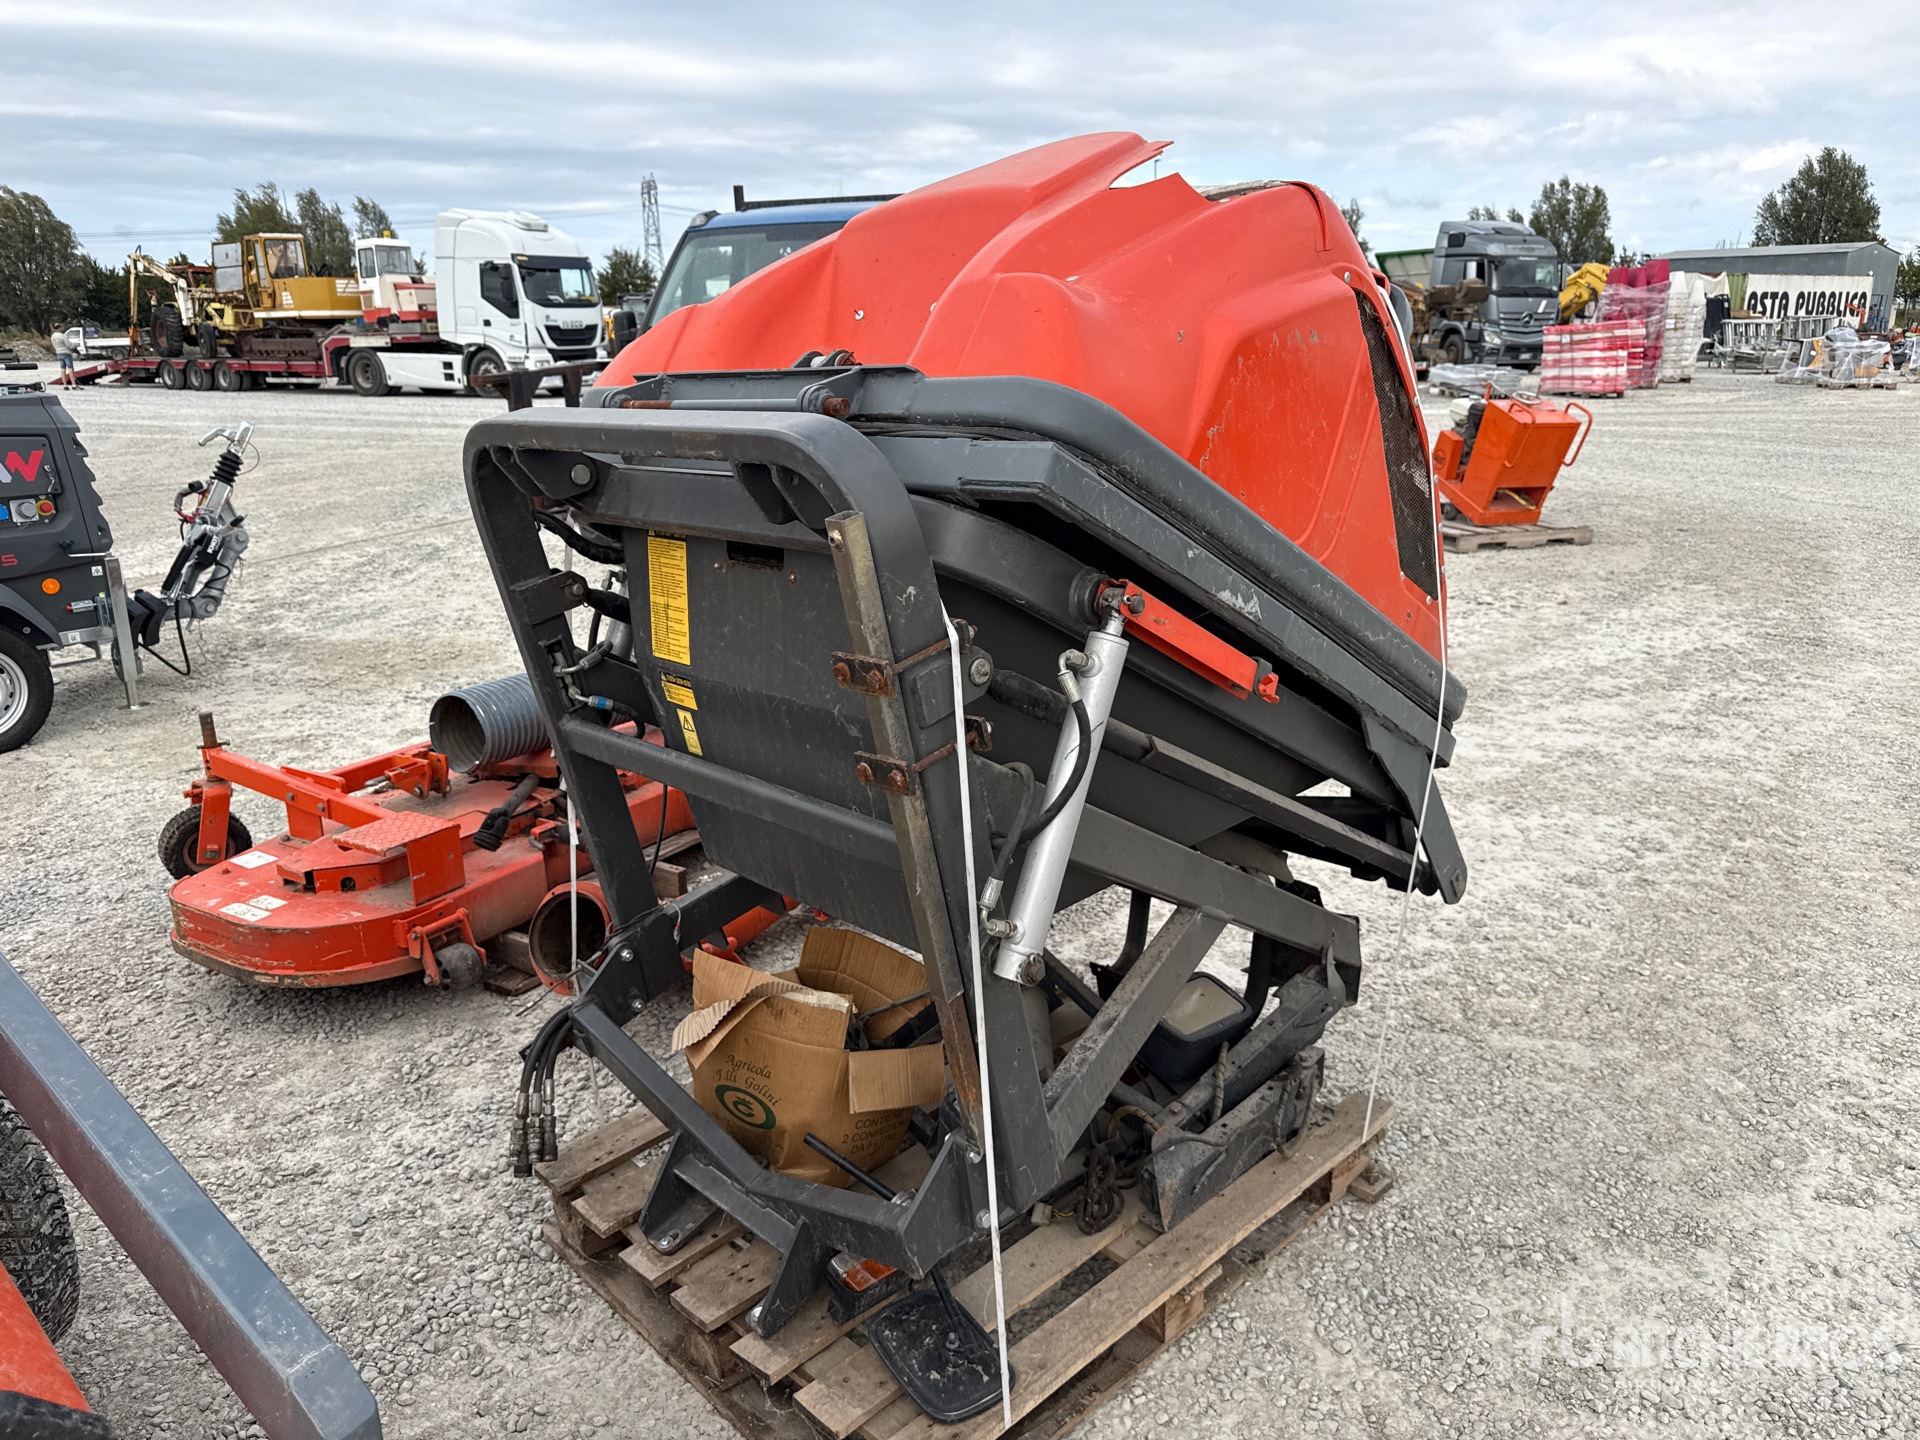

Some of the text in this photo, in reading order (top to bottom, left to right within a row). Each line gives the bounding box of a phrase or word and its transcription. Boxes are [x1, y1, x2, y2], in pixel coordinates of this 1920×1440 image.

[1747, 291, 1868, 319] ASTA PUBBLICA
[726, 1054, 772, 1079] Agricola
[745, 1076, 781, 1106] Golini
[842, 1134, 849, 1144] 2
[851, 1144, 865, 1154] DA
